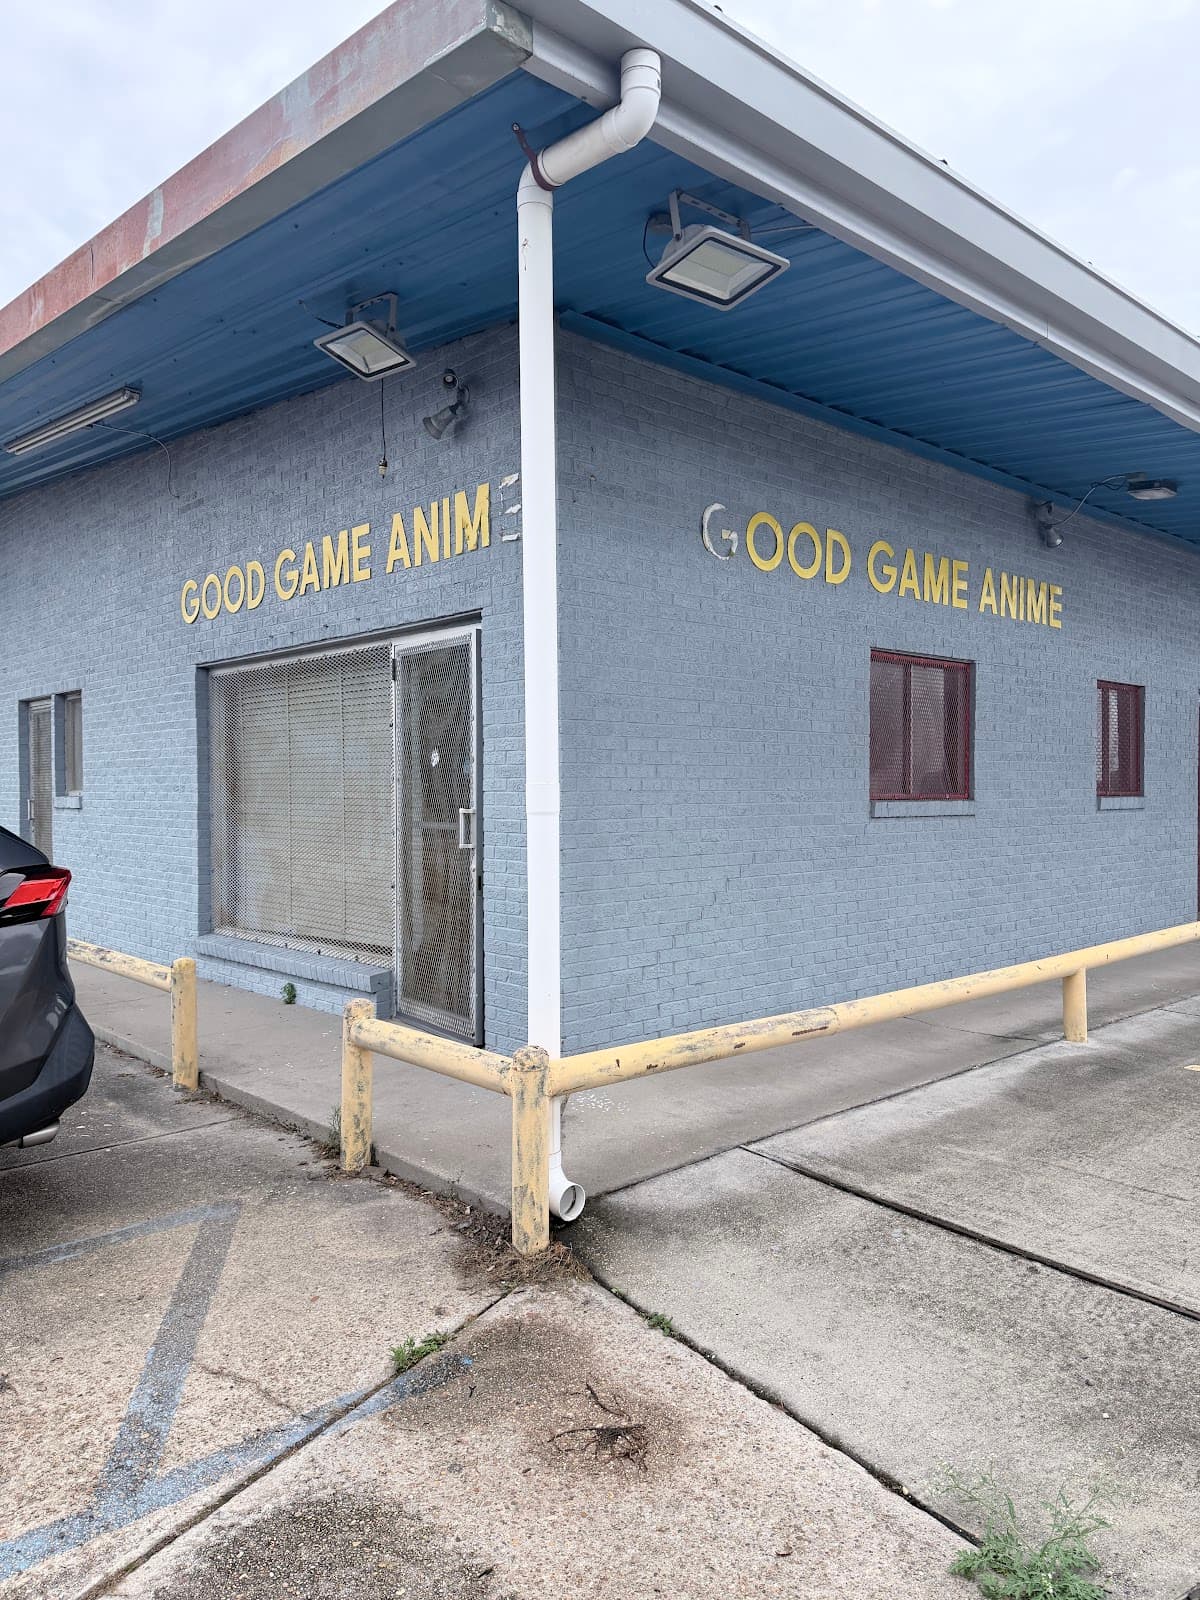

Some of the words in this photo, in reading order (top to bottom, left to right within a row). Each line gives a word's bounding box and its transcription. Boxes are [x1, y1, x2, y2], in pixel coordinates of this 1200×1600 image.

[181, 559, 266, 624] GOOD
[274, 522, 371, 601] GAME
[702, 502, 852, 585] GOOD
[867, 540, 969, 609] GAME
[979, 567, 1063, 628] ANIME
